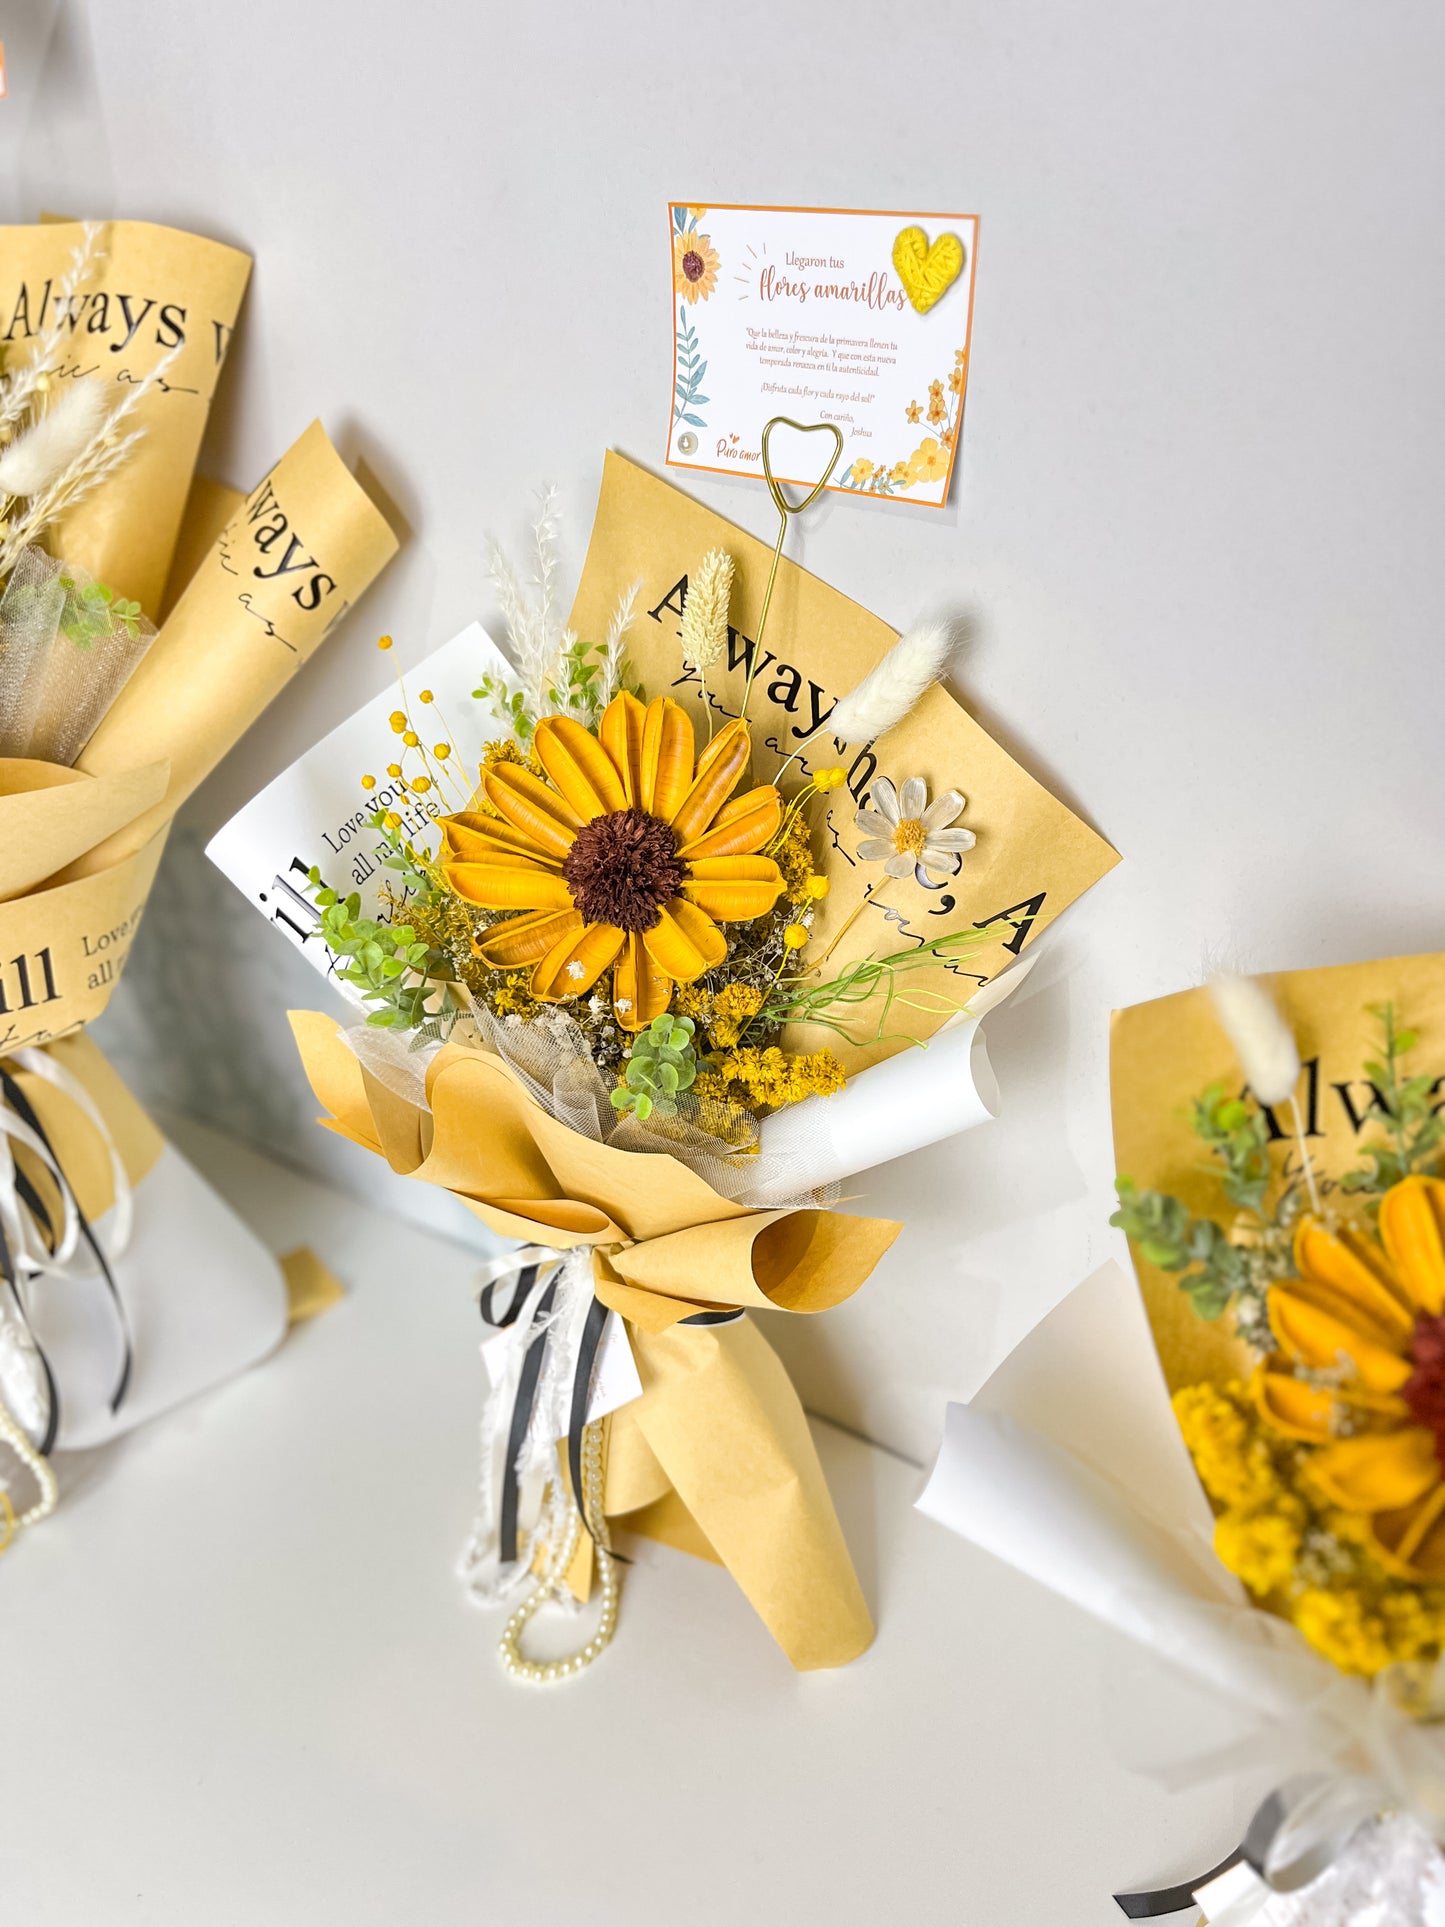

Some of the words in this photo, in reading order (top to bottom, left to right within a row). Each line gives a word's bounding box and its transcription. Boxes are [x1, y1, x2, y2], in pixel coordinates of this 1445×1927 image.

[785, 250, 827, 271] Llegaron
[829, 255, 845, 269] tus
[760, 264, 811, 303] flores
[814, 271, 907, 311] amarillas
[761, 328, 767, 338] la
[768, 328, 789, 340] belleza
[793, 331, 819, 344] frescura
[819, 333, 828, 344] de
[828, 334, 835, 345] la
[836, 336, 869, 347] primavera
[869, 337, 890, 350] llenen
[890, 341, 898, 350] tu
[746, 341, 758, 350] vida
[759, 341, 767, 351] de
[832, 349, 838, 358] Y
[838, 352, 850, 362] que
[850, 352, 862, 361] con
[863, 353, 876, 363] esta
[877, 356, 896, 365] nueva
[759, 356, 792, 368] temporada
[792, 361, 816, 370] renazca
[817, 363, 825, 371] en
[826, 362, 831, 372] ti
[831, 361, 838, 373] la
[787, 385, 802, 395] cada
[801, 386, 814, 398] flor
[819, 388, 834, 399] cada
[835, 393, 849, 403] rayo
[849, 391, 860, 402] del
[819, 409, 833, 420] Con
[849, 426, 873, 438] Joshua
[716, 438, 737, 459] Puro
[739, 449, 762, 462] amor
[321, 810, 365, 855] Love
[351, 852, 376, 886] all
[401, 801, 441, 838] life
[88, 959, 114, 990] all
